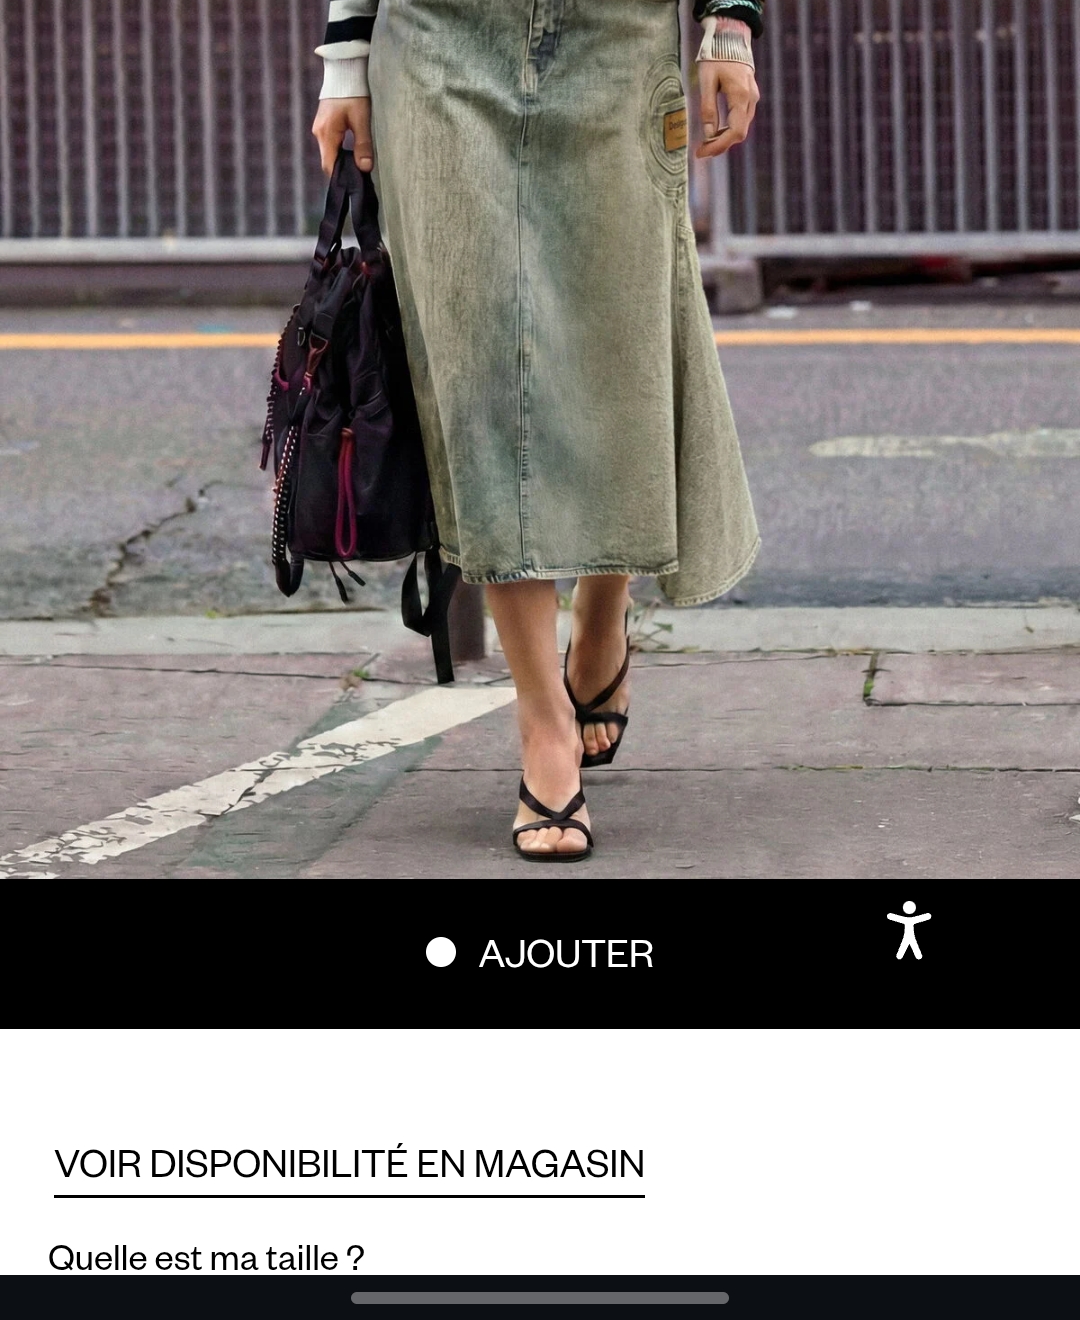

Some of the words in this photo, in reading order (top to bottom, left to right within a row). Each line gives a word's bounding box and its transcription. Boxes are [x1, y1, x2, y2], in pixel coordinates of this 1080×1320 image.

[478, 938, 654, 969] AJOUTER
[54, 1148, 141, 1179] VOIR
[151, 1142, 408, 1179] DISPONIBILITÉ
[418, 1149, 465, 1178] EN
[475, 1148, 644, 1179] MAGASIN
[48, 1244, 148, 1271] Quelle
[154, 1246, 203, 1271] est
[211, 1251, 260, 1271] ma
[265, 1244, 339, 1271] taille
[346, 1244, 365, 1271] ?
